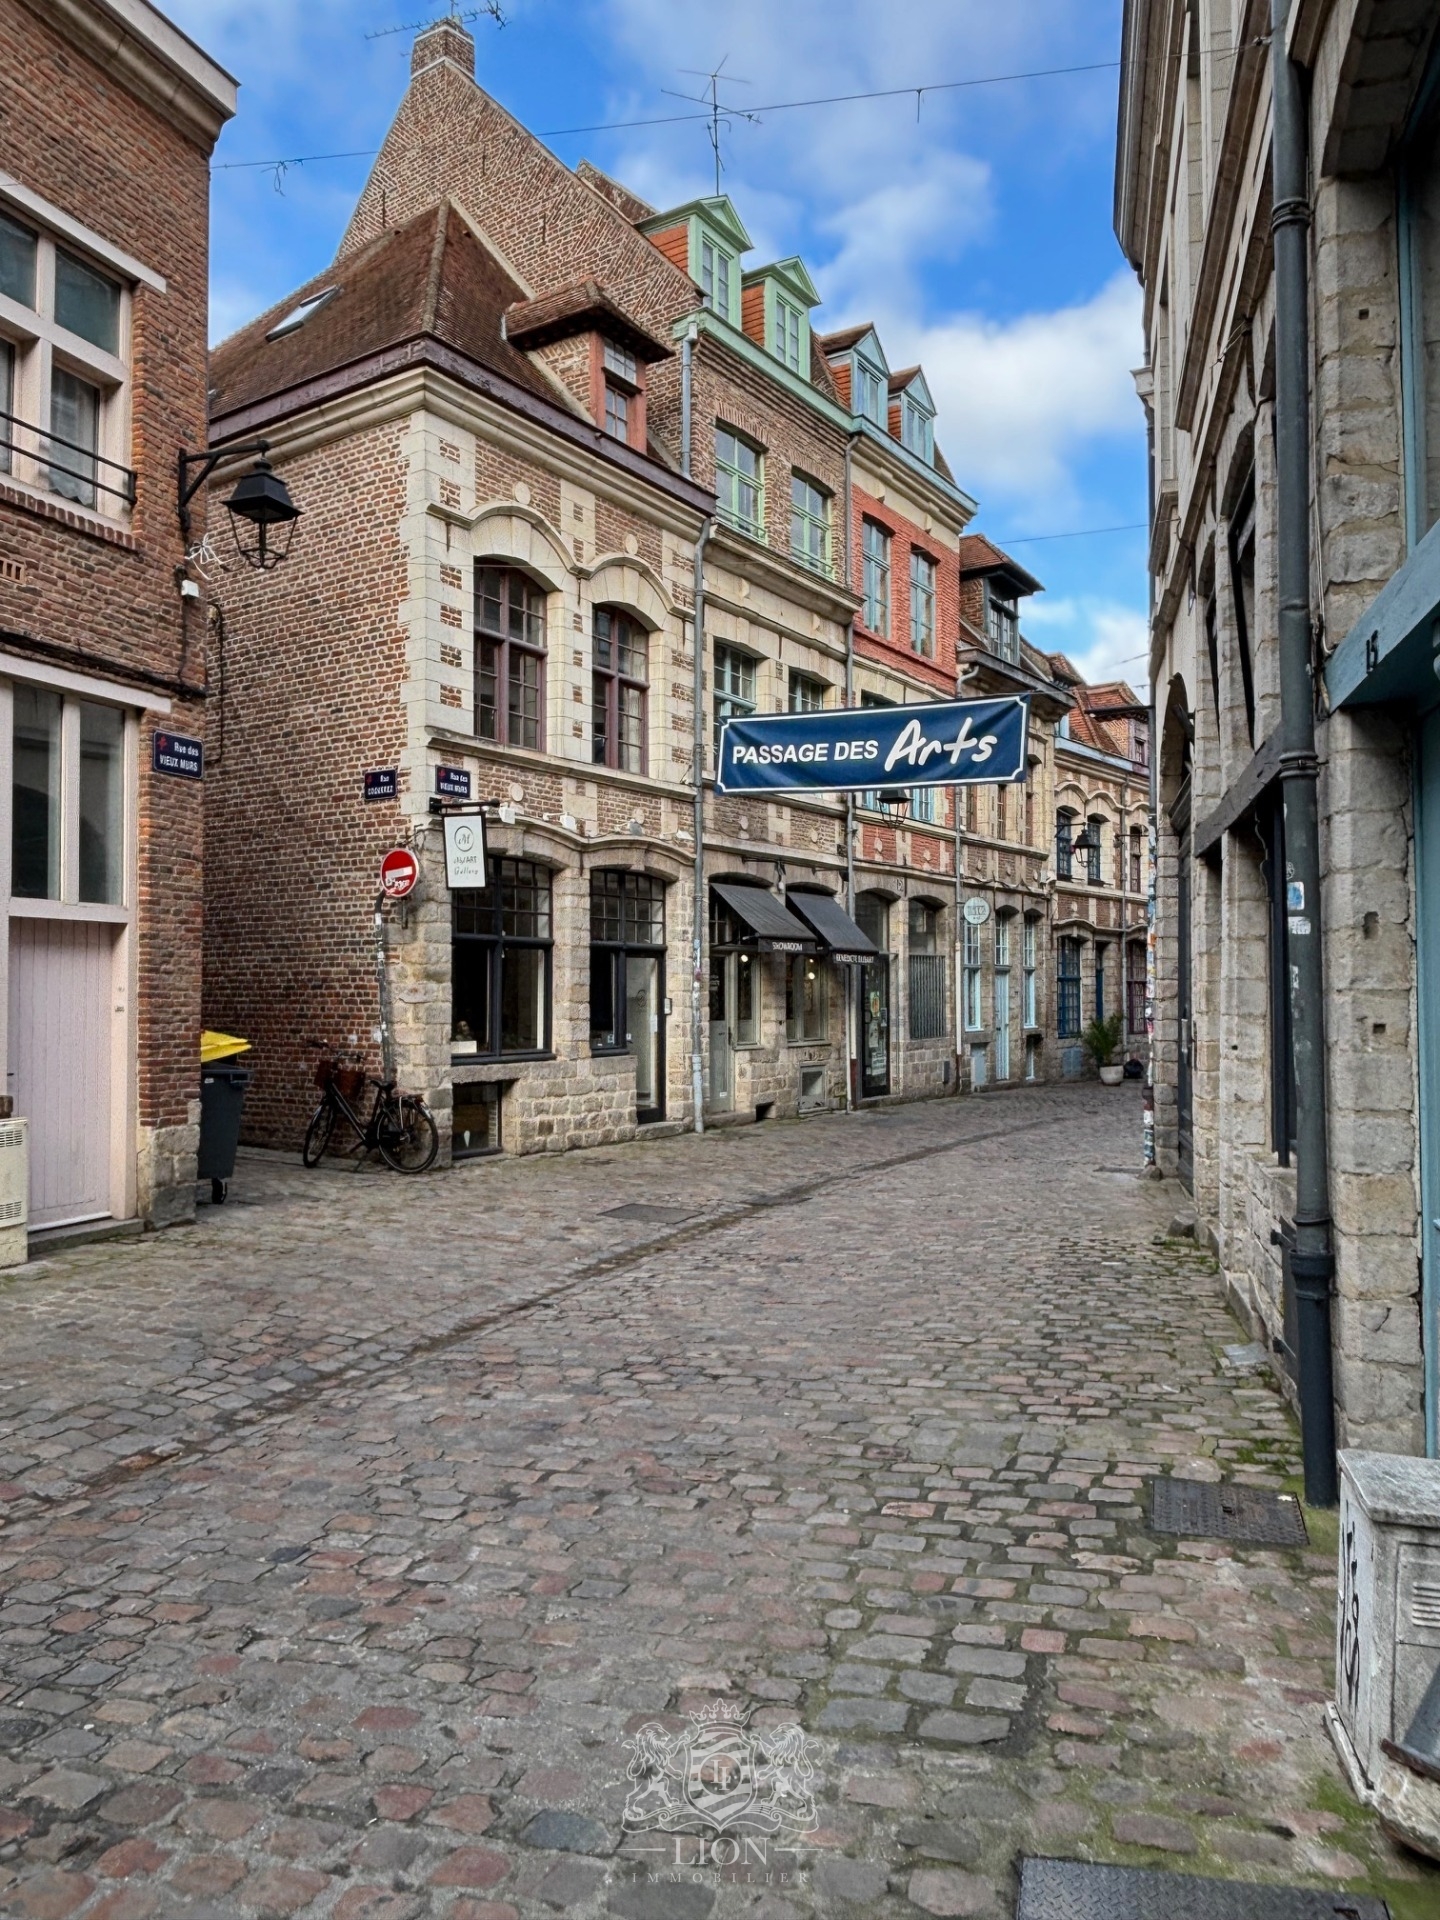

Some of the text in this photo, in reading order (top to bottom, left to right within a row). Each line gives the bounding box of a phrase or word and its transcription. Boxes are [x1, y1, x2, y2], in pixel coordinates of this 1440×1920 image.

[174, 742, 199, 756] Rue des
[732, 717, 998, 772] PASSAGE DES Arts
[160, 754, 198, 771] VIEUX MURS
